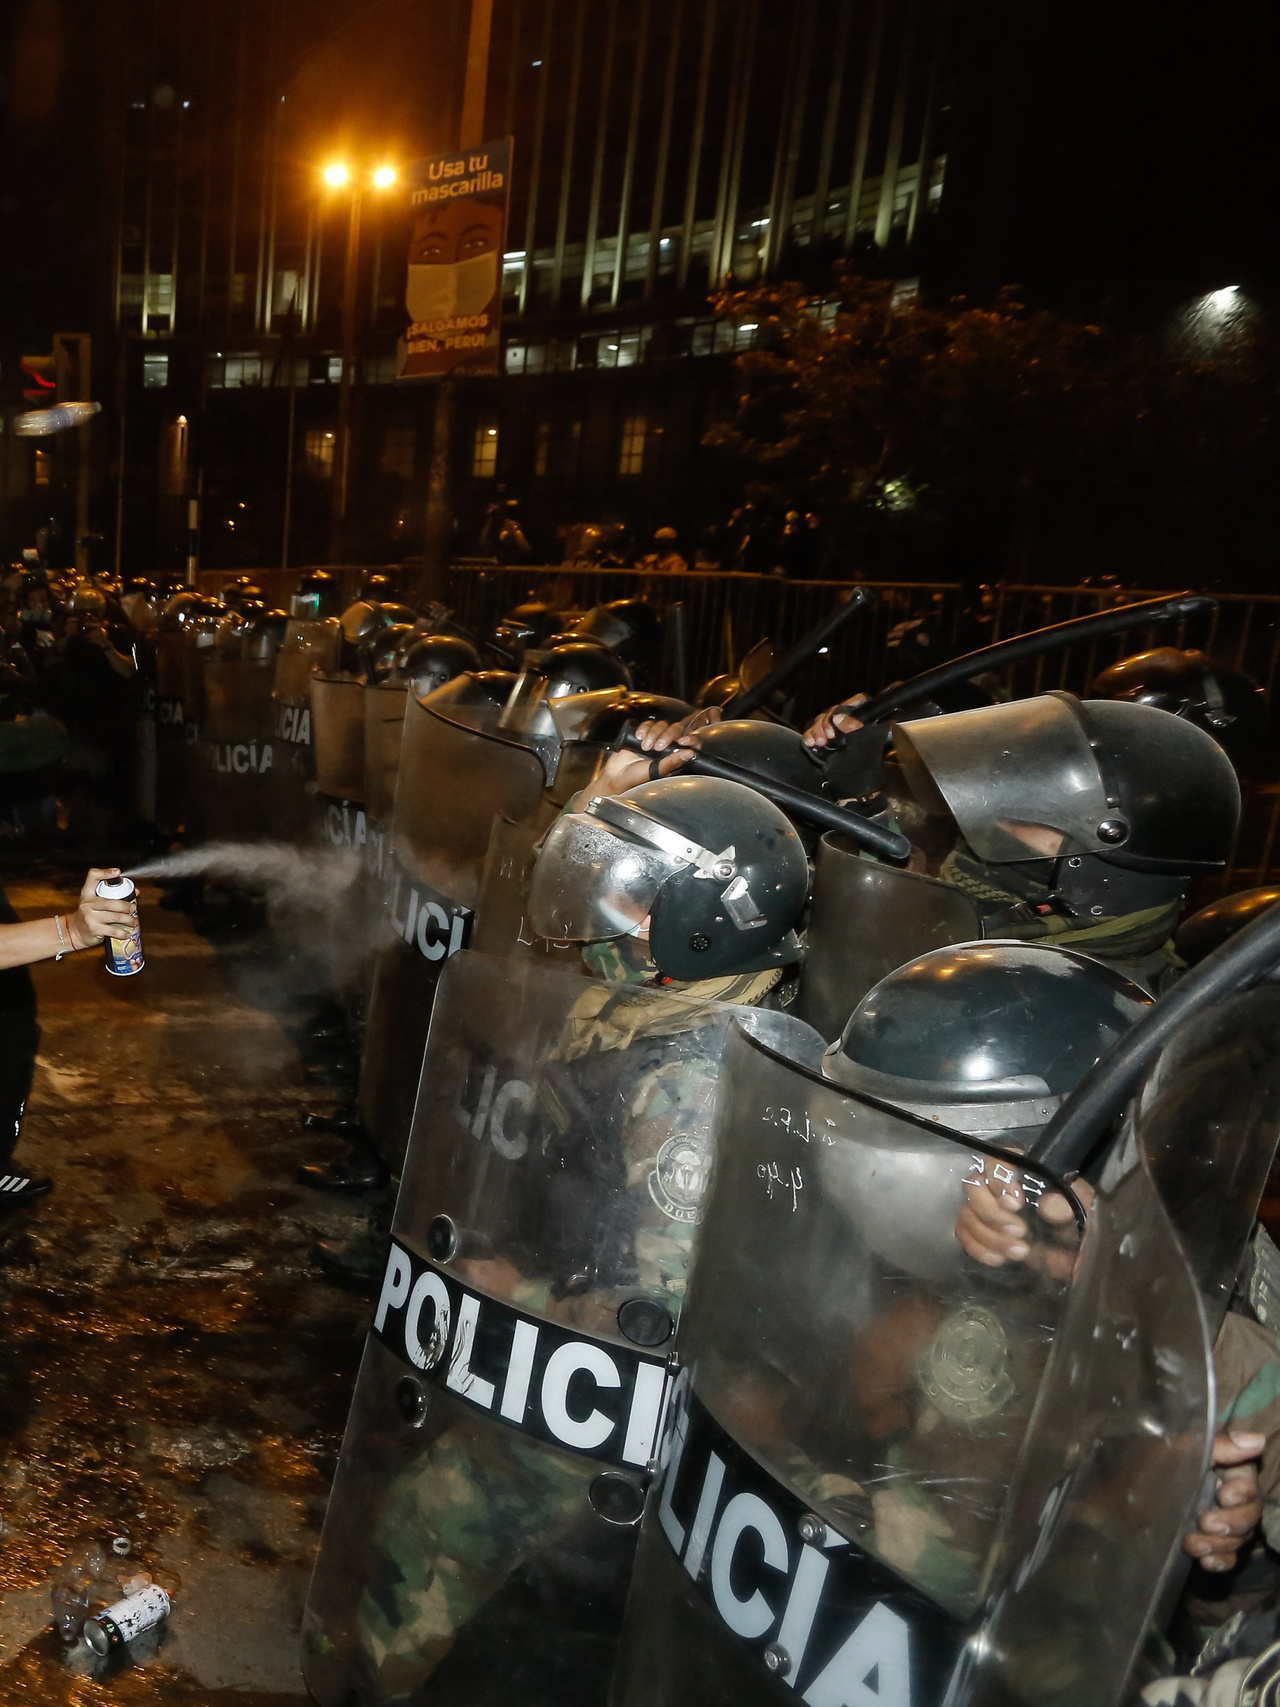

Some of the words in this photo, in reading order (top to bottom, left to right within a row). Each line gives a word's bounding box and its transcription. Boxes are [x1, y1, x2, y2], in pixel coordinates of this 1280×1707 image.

[428, 160, 465, 180] Usa
[469, 154, 489, 173] tu
[411, 170, 504, 205] mascarilla
